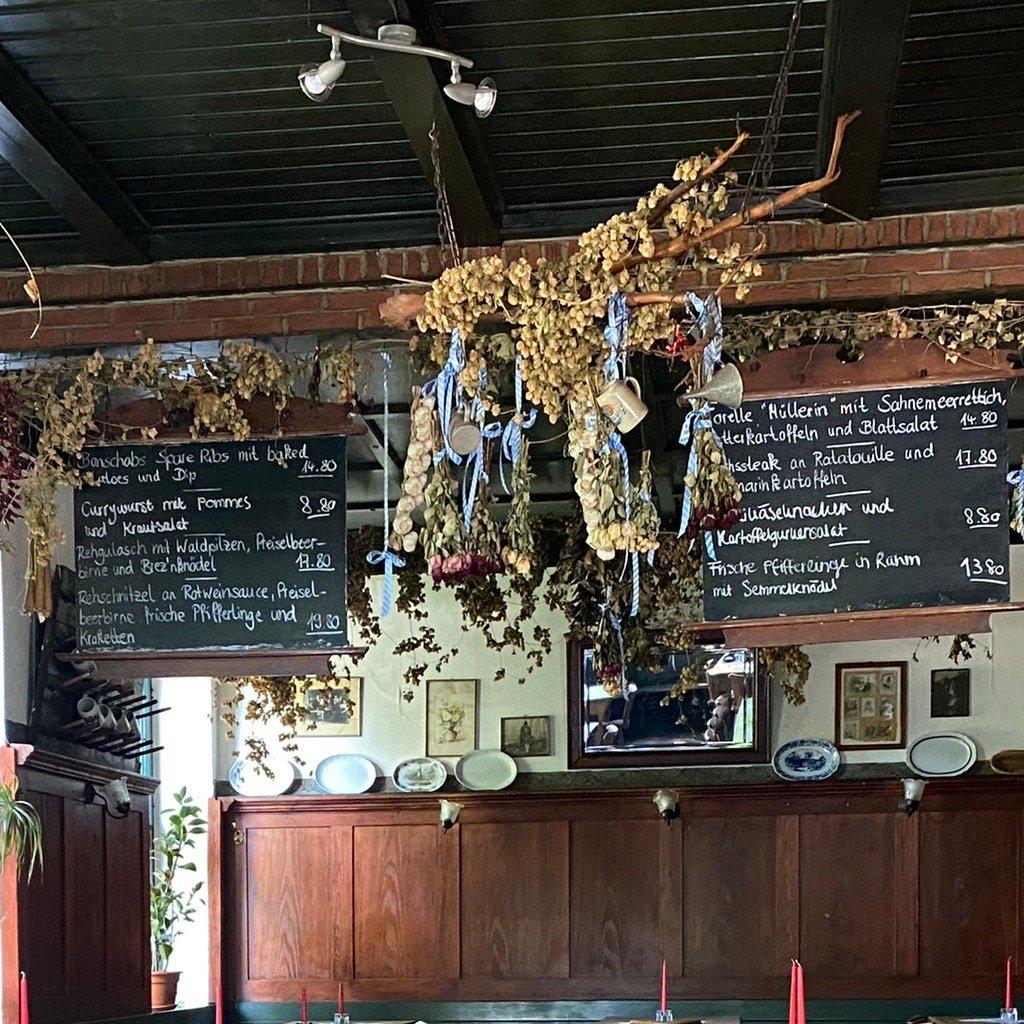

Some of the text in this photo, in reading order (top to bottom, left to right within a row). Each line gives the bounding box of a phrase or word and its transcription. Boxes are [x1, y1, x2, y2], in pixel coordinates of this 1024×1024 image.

[711, 406, 753, 424] orelle
[840, 397, 869, 415] mit
[721, 414, 939, 445] tterkartoffeln und Blattsalat
[156, 446, 194, 471] Spare
[200, 448, 230, 463] Ribs
[238, 445, 259, 461] mit
[267, 443, 309, 462] baked
[302, 459, 337, 474] 14.80
[726, 442, 935, 473] hssteak an Ratatouille und
[955, 448, 998, 466] 17.80
[97, 467, 196, 486] atoes und Dip
[81, 495, 251, 525] Currywurst mit Pommes
[299, 495, 336, 514] 8.80
[862, 497, 894, 515] und
[84, 516, 190, 538] und Krautsalat
[964, 507, 1001, 525] 8.80
[716, 522, 848, 548] Kartoffelgurkensalat
[77, 540, 147, 566] Rehgulasch
[152, 539, 170, 555] mit
[176, 536, 251, 556] Waldpilzen,
[78, 563, 108, 579] birne
[112, 560, 134, 576] und
[707, 551, 921, 579] Frische Pfifferlinge in Rahm
[77, 580, 327, 606] Rehschnitzel an Rotweinsauce, Preisel-
[713, 578, 838, 598] mit Semmelknödel
[79, 608, 135, 626] beerbirne
[144, 604, 185, 625] frische
[270, 604, 297, 622] und
